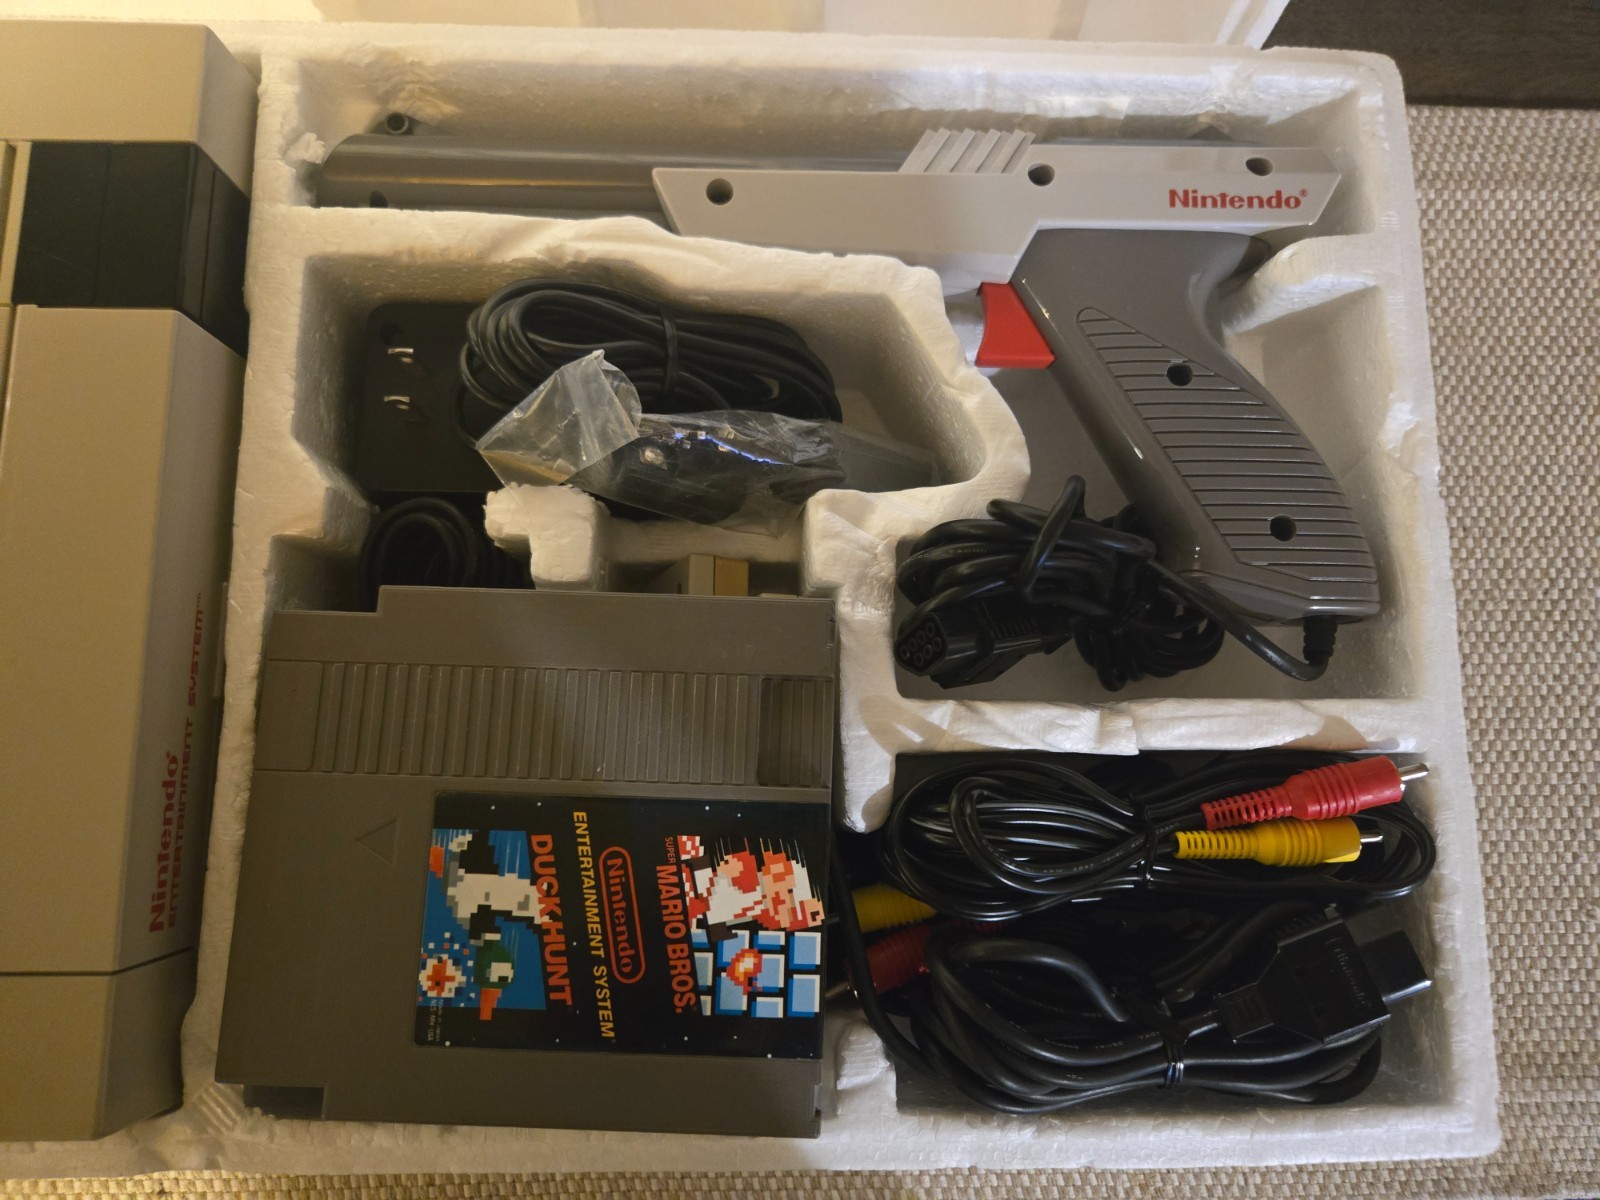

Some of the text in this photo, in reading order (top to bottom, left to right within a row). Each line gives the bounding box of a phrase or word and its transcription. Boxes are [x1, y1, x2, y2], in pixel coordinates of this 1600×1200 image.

[168, 718, 194, 927] ENTERTAINMENT
[531, 834, 573, 1006] DUCK HUNT
[573, 811, 615, 1037] ENTERTAINMENT SYSTEM
[606, 858, 635, 973] Nintendo
[656, 836, 696, 1014] SUPER MARIO BROS.
